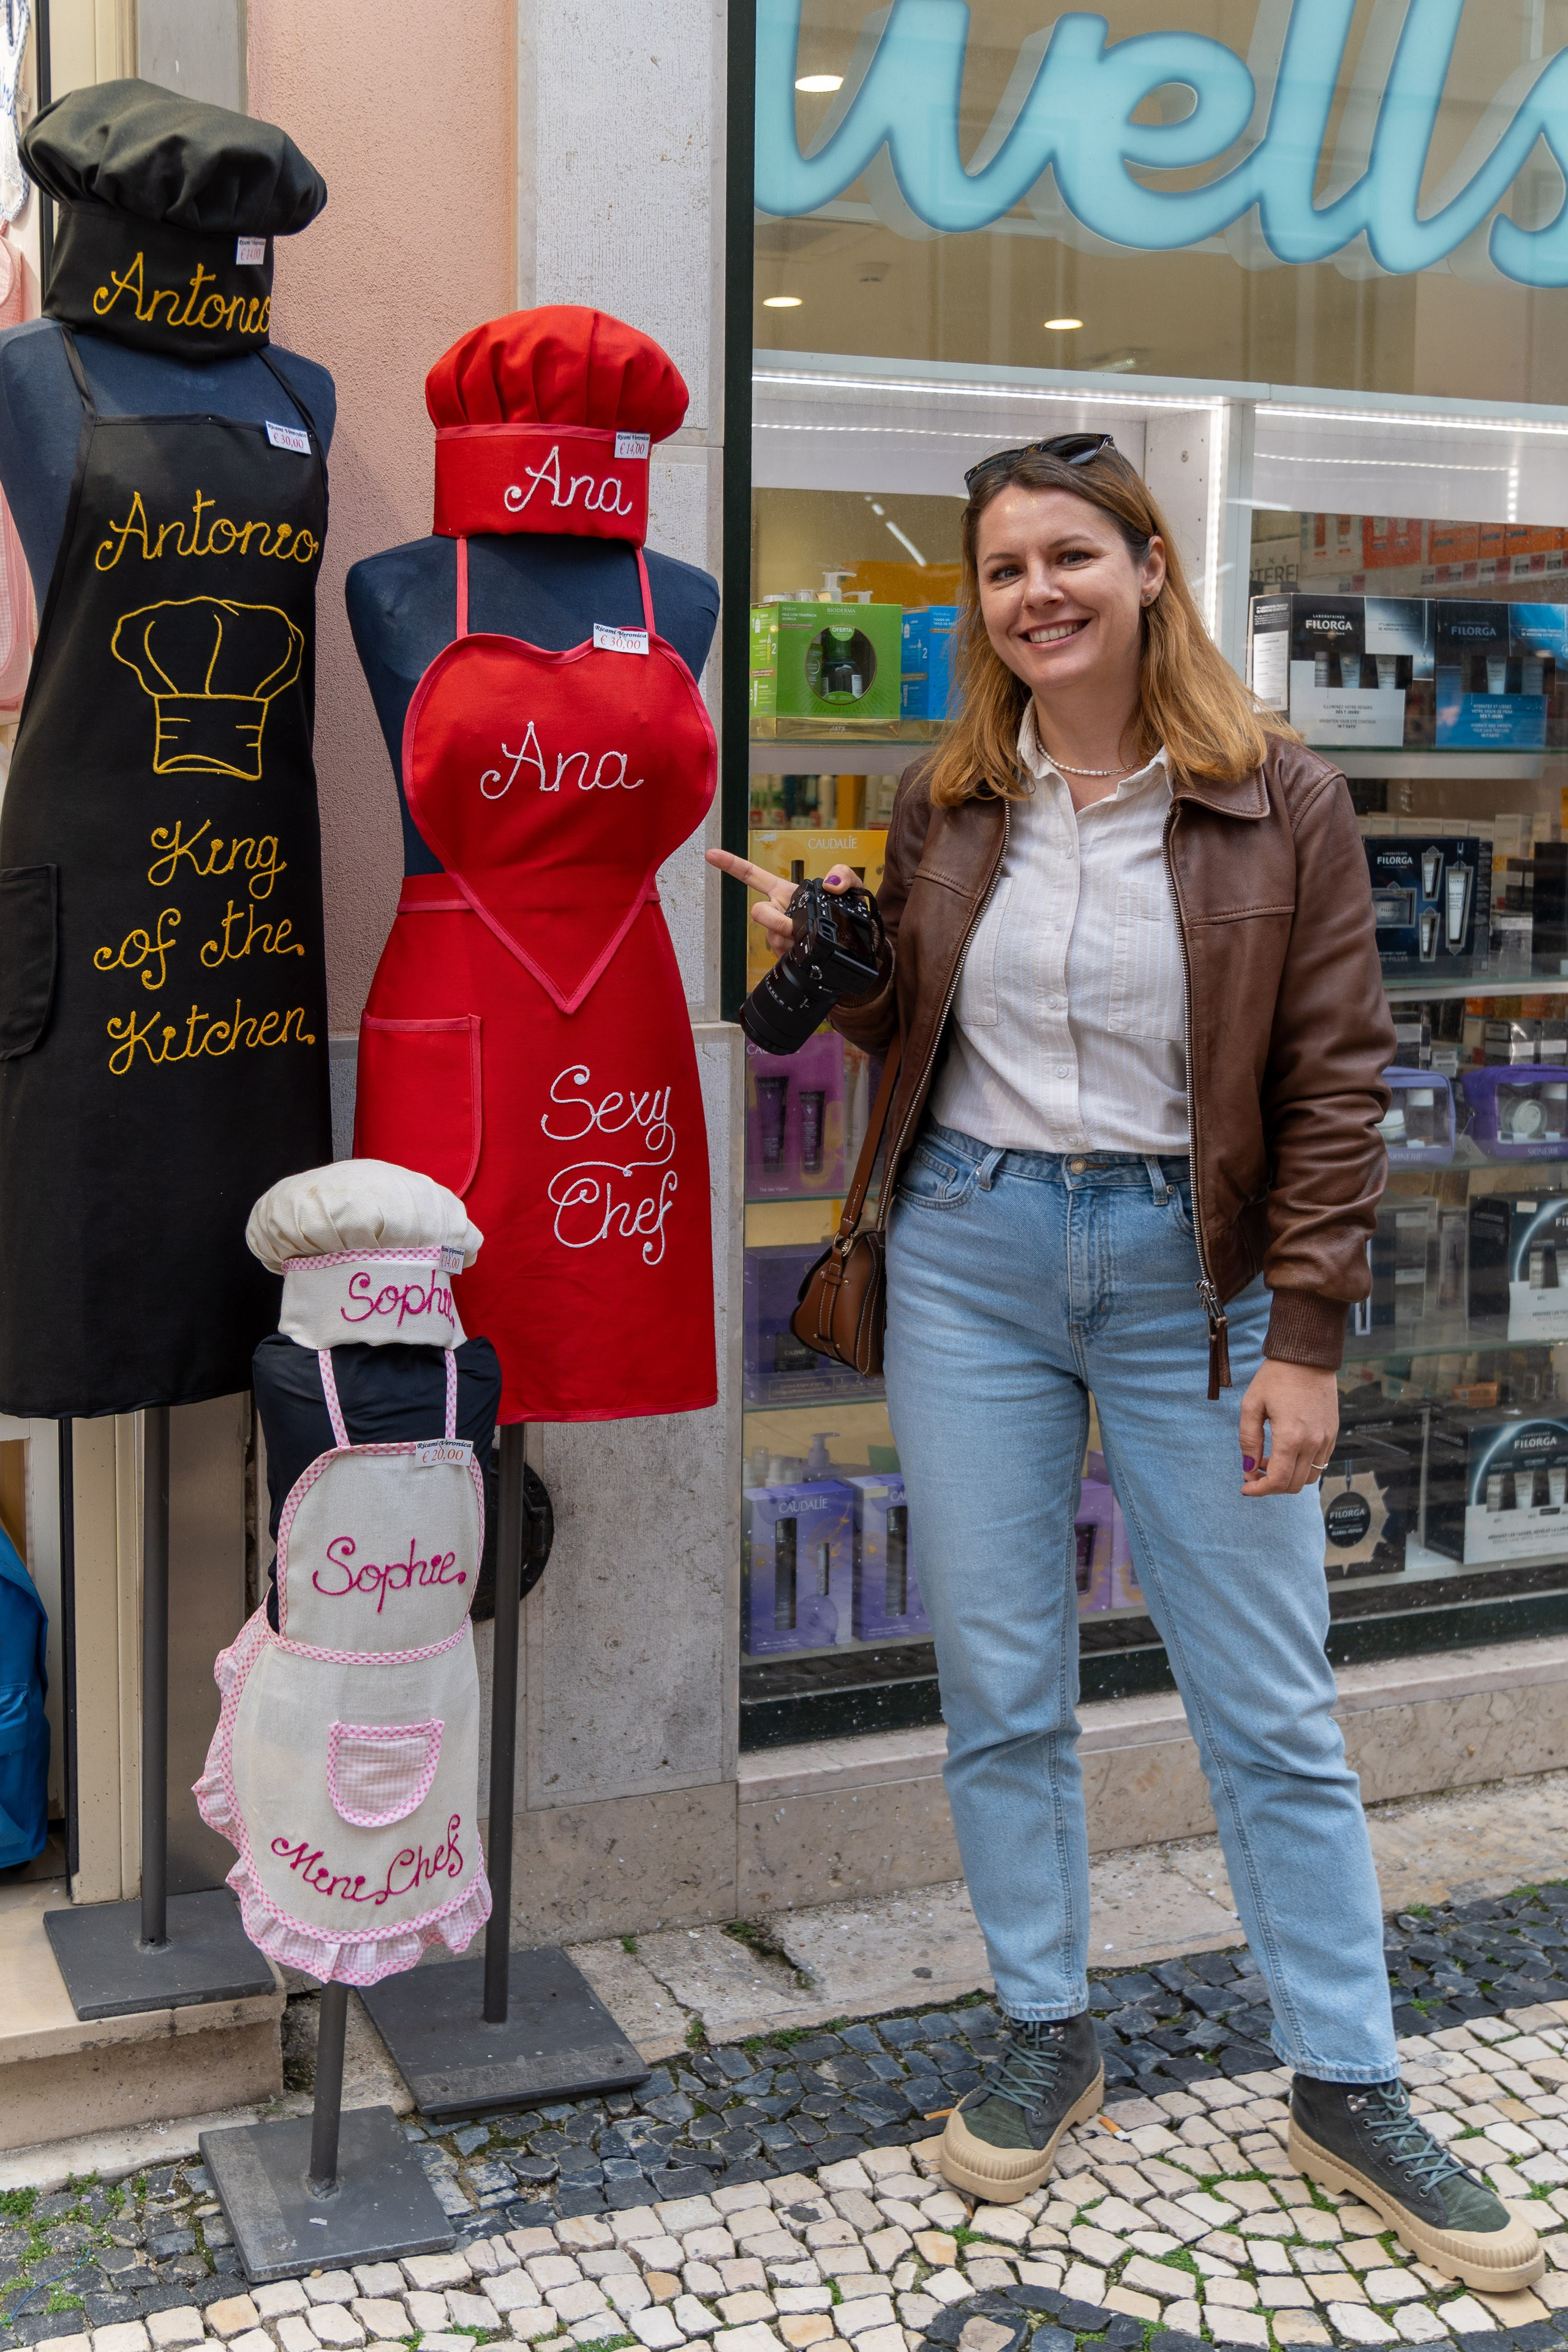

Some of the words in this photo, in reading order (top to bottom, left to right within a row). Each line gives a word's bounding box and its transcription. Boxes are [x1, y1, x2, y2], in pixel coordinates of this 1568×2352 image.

[268, 424, 284, 432] Ricami
[285, 429, 306, 438] Veronica
[282, 435, 304, 449] 30,00
[627, 443, 644, 456] 14,00
[504, 446, 633, 516] Ana
[96, 489, 318, 571] Antonio
[595, 625, 616, 635] Ricami
[1306, 620, 1352, 630] FILORGA
[1452, 627, 1496, 636] FILORGA
[601, 635, 607, 645] €
[610, 637, 641, 650] 30,00
[772, 643, 776, 655] 2
[922, 647, 927, 658] 2
[480, 721, 644, 800] Ana
[809, 835, 856, 849] CAUDALÍE
[148, 820, 287, 900] King
[1377, 856, 1413, 865] FILORGA
[94, 908, 181, 990] of
[200, 900, 304, 968] the
[107, 998, 315, 1076] Kitchen
[541, 1065, 675, 1166] Sexy
[1527, 1147, 1558, 1156] SKINERIE
[548, 1161, 678, 1265] Chef
[1514, 1436, 1557, 1449] FILORGA
[423, 1451, 430, 1463] €
[432, 1449, 464, 1461] 20,00
[778, 1496, 827, 1513] CAUDALÍE
[1330, 1509, 1365, 1519] FILORGA
[312, 1536, 466, 1614] Sophie
[271, 1836, 388, 1905] Mini
[386, 1814, 464, 1896] Chef
